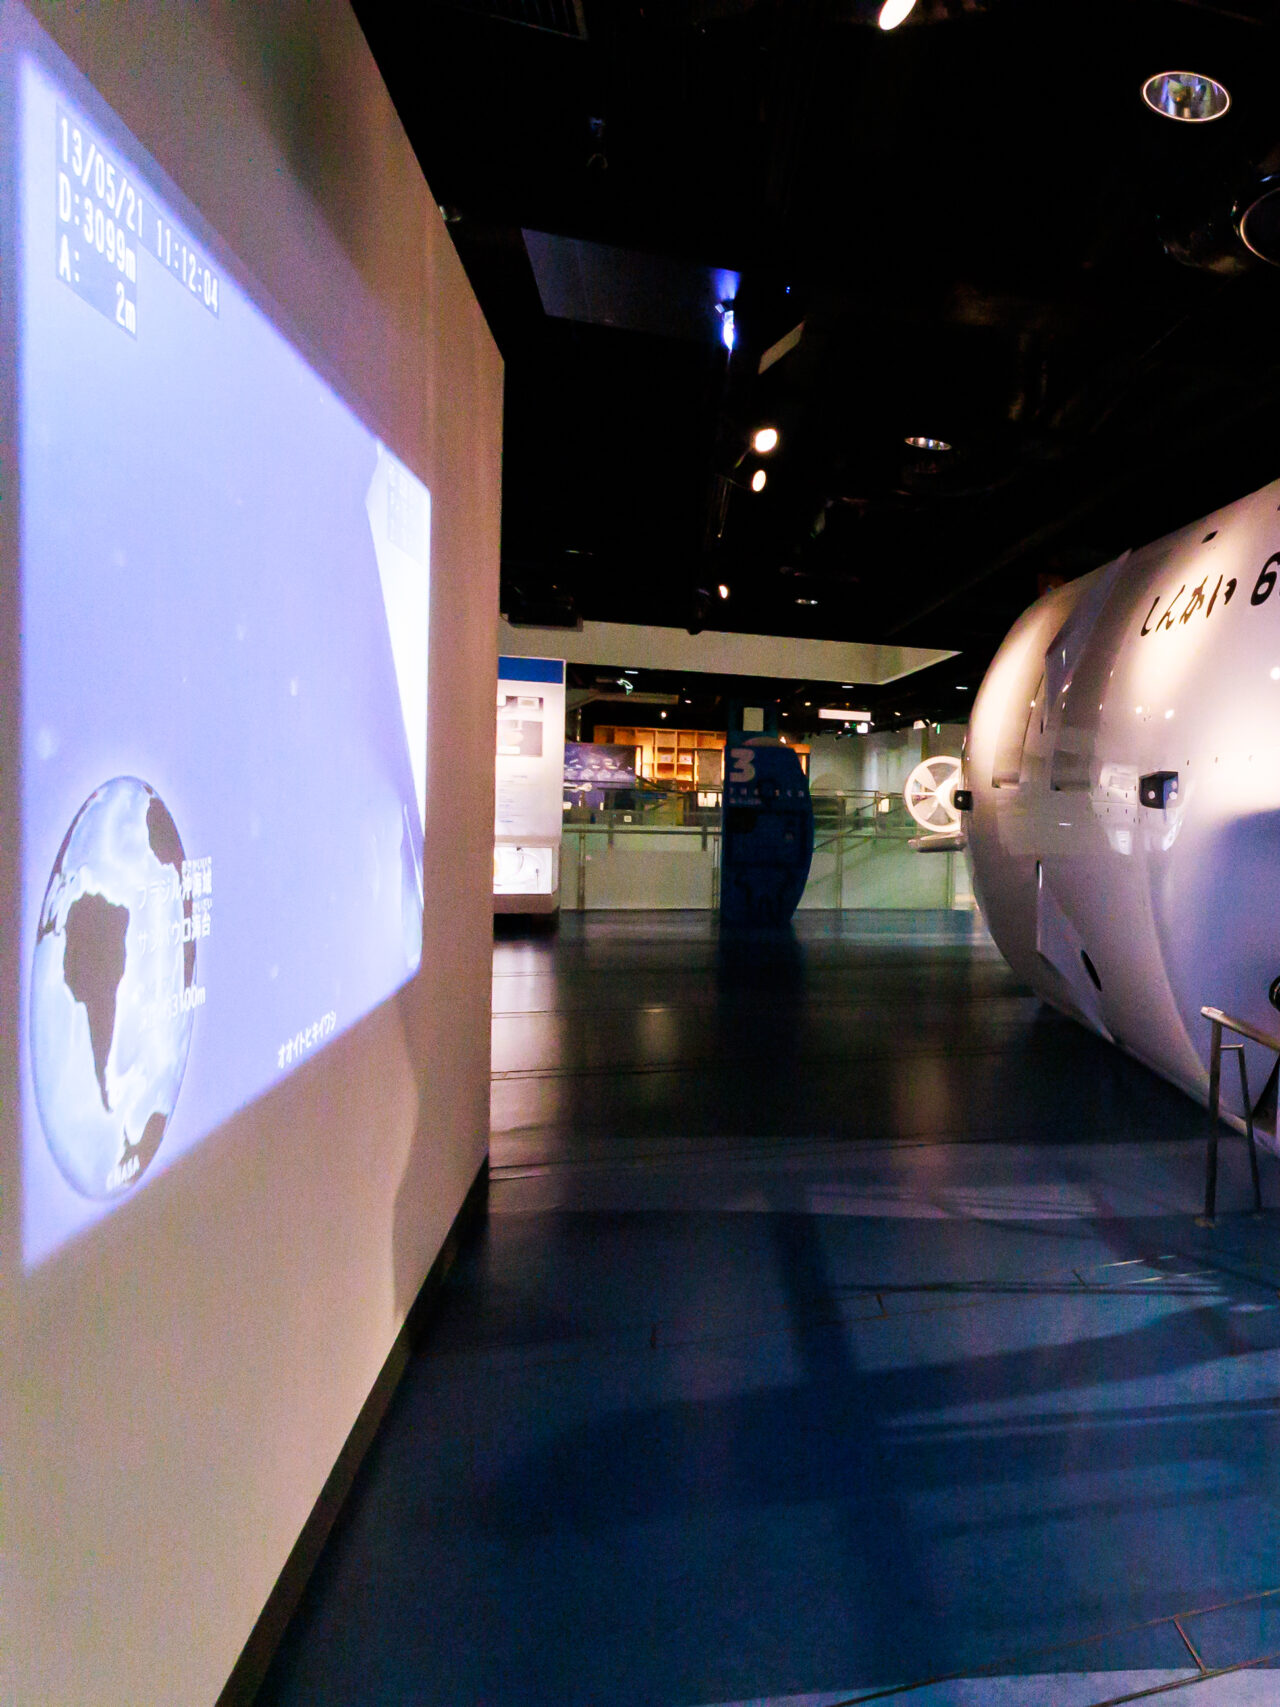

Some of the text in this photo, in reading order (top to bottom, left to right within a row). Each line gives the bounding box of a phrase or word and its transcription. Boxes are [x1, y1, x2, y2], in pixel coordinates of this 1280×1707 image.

[58, 171, 137, 284] D:3099m
[60, 118, 220, 314] 13/05/21 11:12:04
[58, 234, 137, 335] A: 2m
[729, 747, 756, 783] 3
